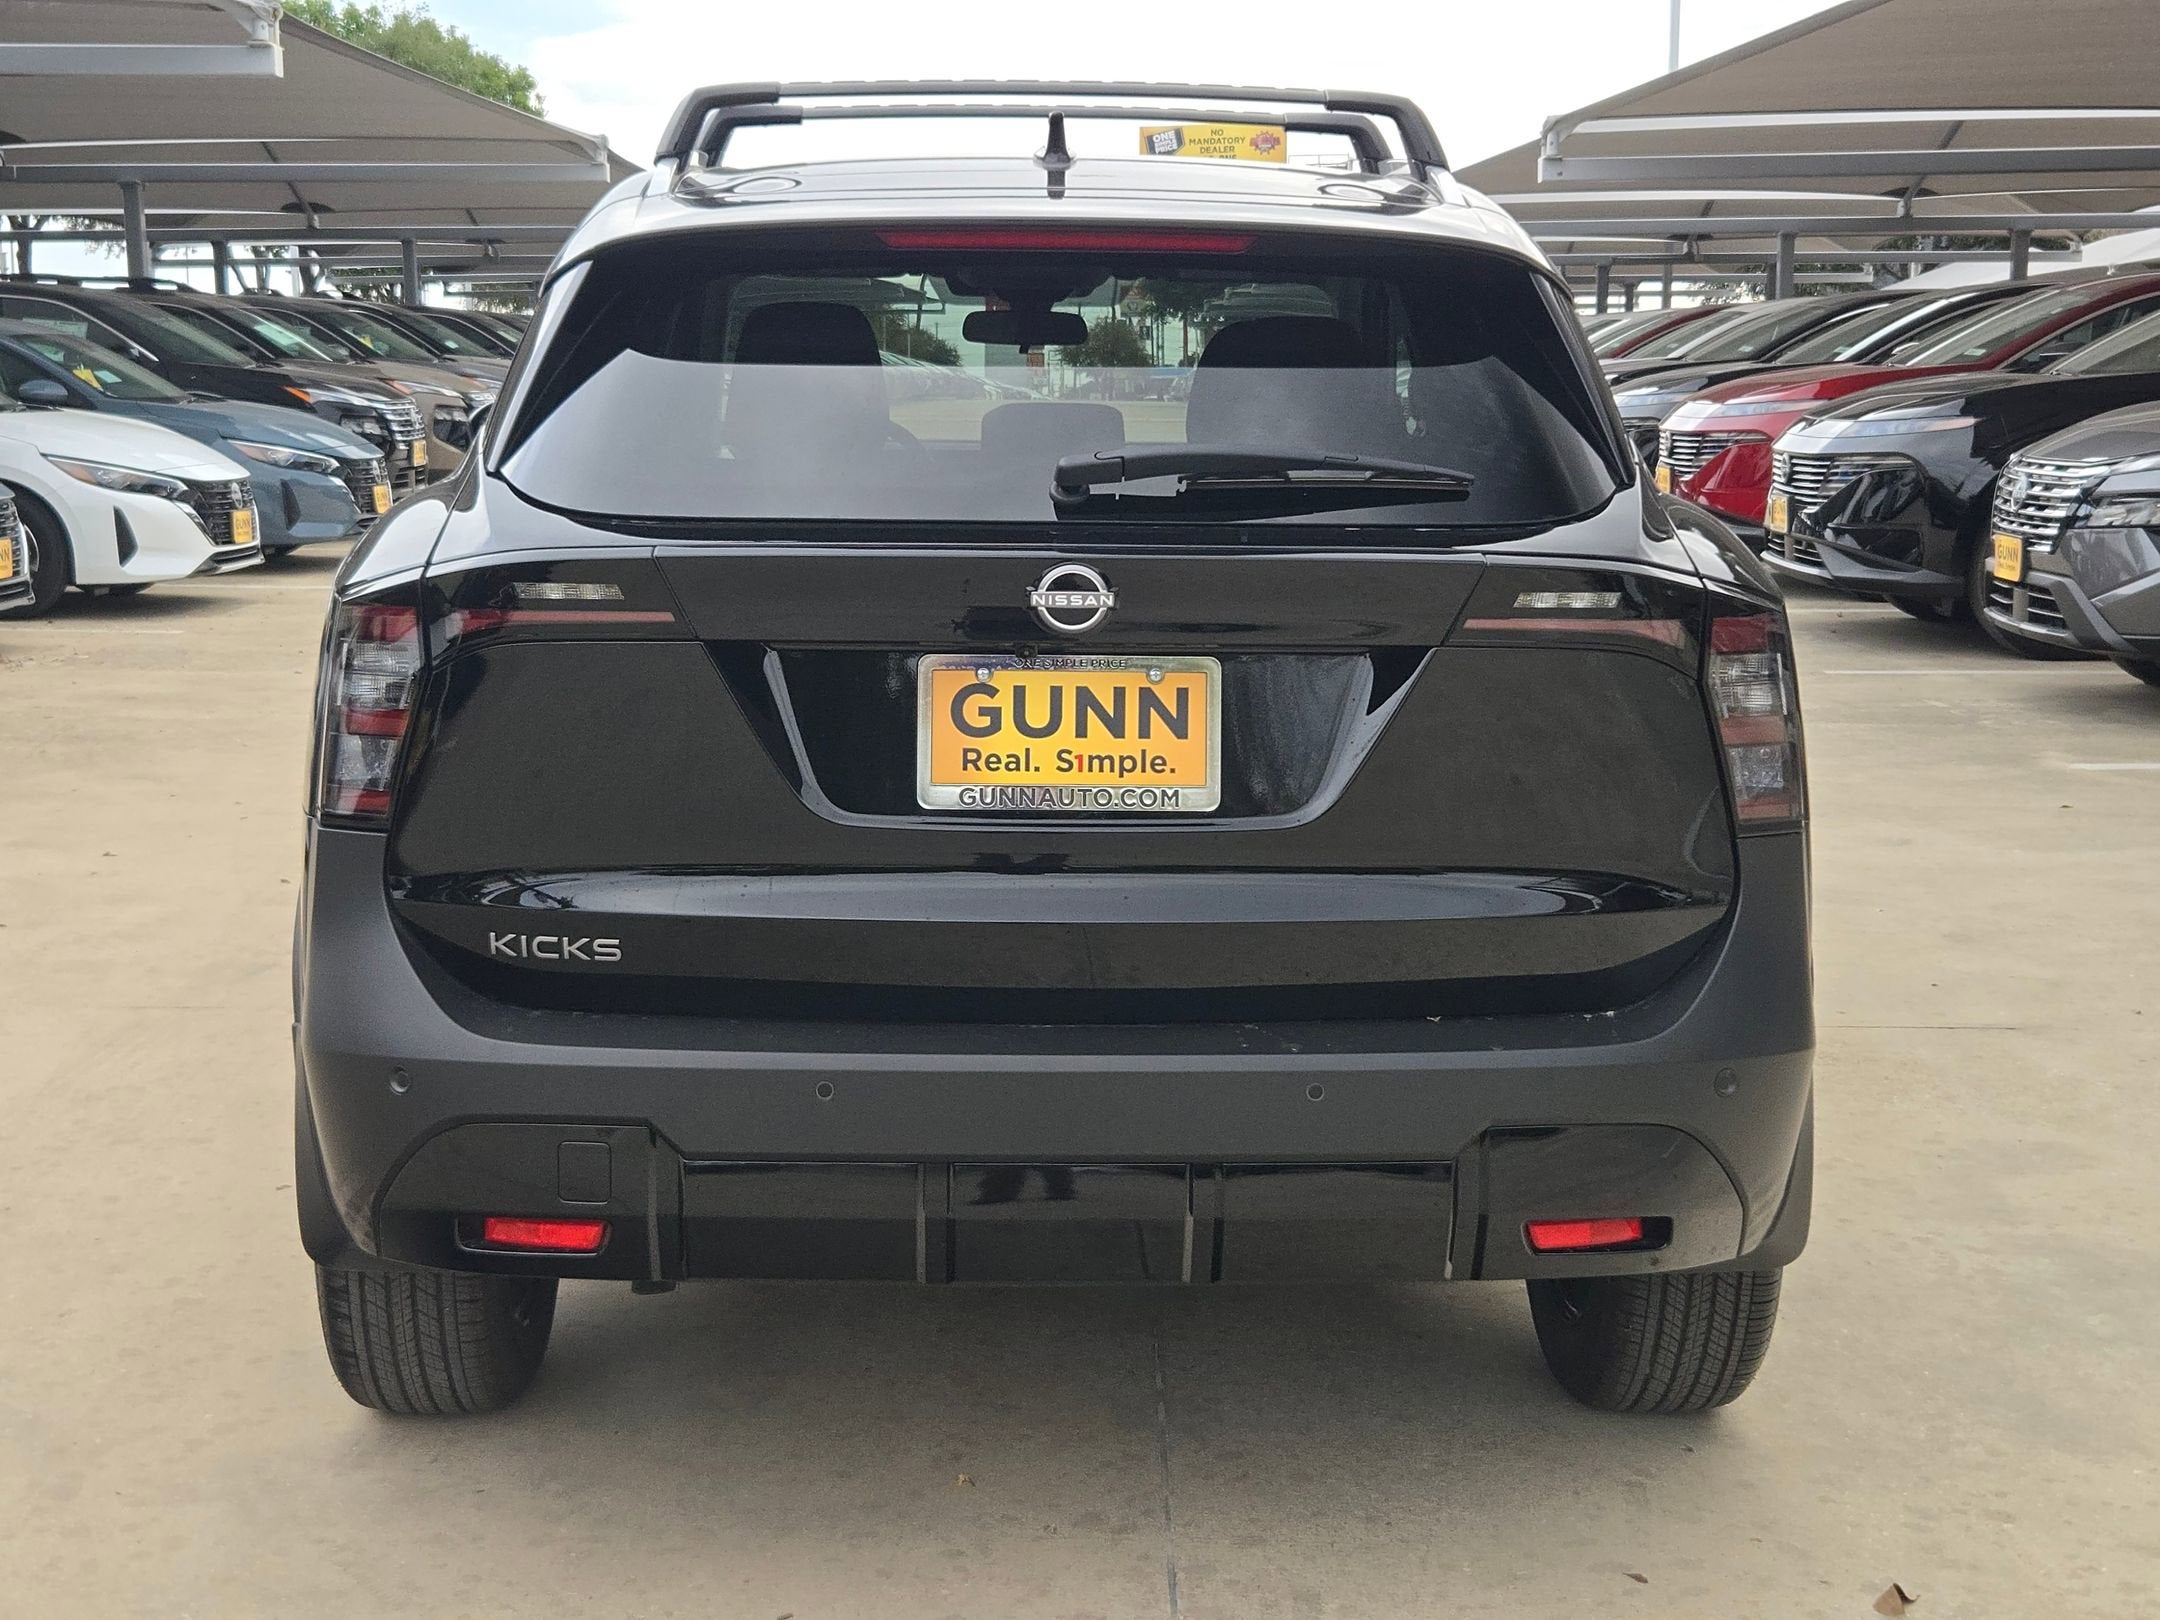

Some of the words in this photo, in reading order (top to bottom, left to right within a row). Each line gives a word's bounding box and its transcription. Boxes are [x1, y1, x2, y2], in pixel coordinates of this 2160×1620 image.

[1152, 130, 1176, 143] ONE
[1210, 129, 1224, 137] NO
[1188, 137, 1246, 146] MANDATORY
[1155, 144, 1178, 154] PRICE
[1199, 145, 1235, 154] DEALER
[1997, 543, 2019, 563] GUNN
[1030, 593, 1114, 606] NISSAN
[1044, 658, 1087, 669] SIMPLE
[1090, 658, 1127, 669] PRICE
[949, 682, 1189, 740] GUNN
[961, 747, 1040, 773] Real.
[1055, 748, 1176, 778] S1mple.
[958, 786, 1180, 809] GUNNAUTO.COM
[489, 931, 623, 963] KICKS
